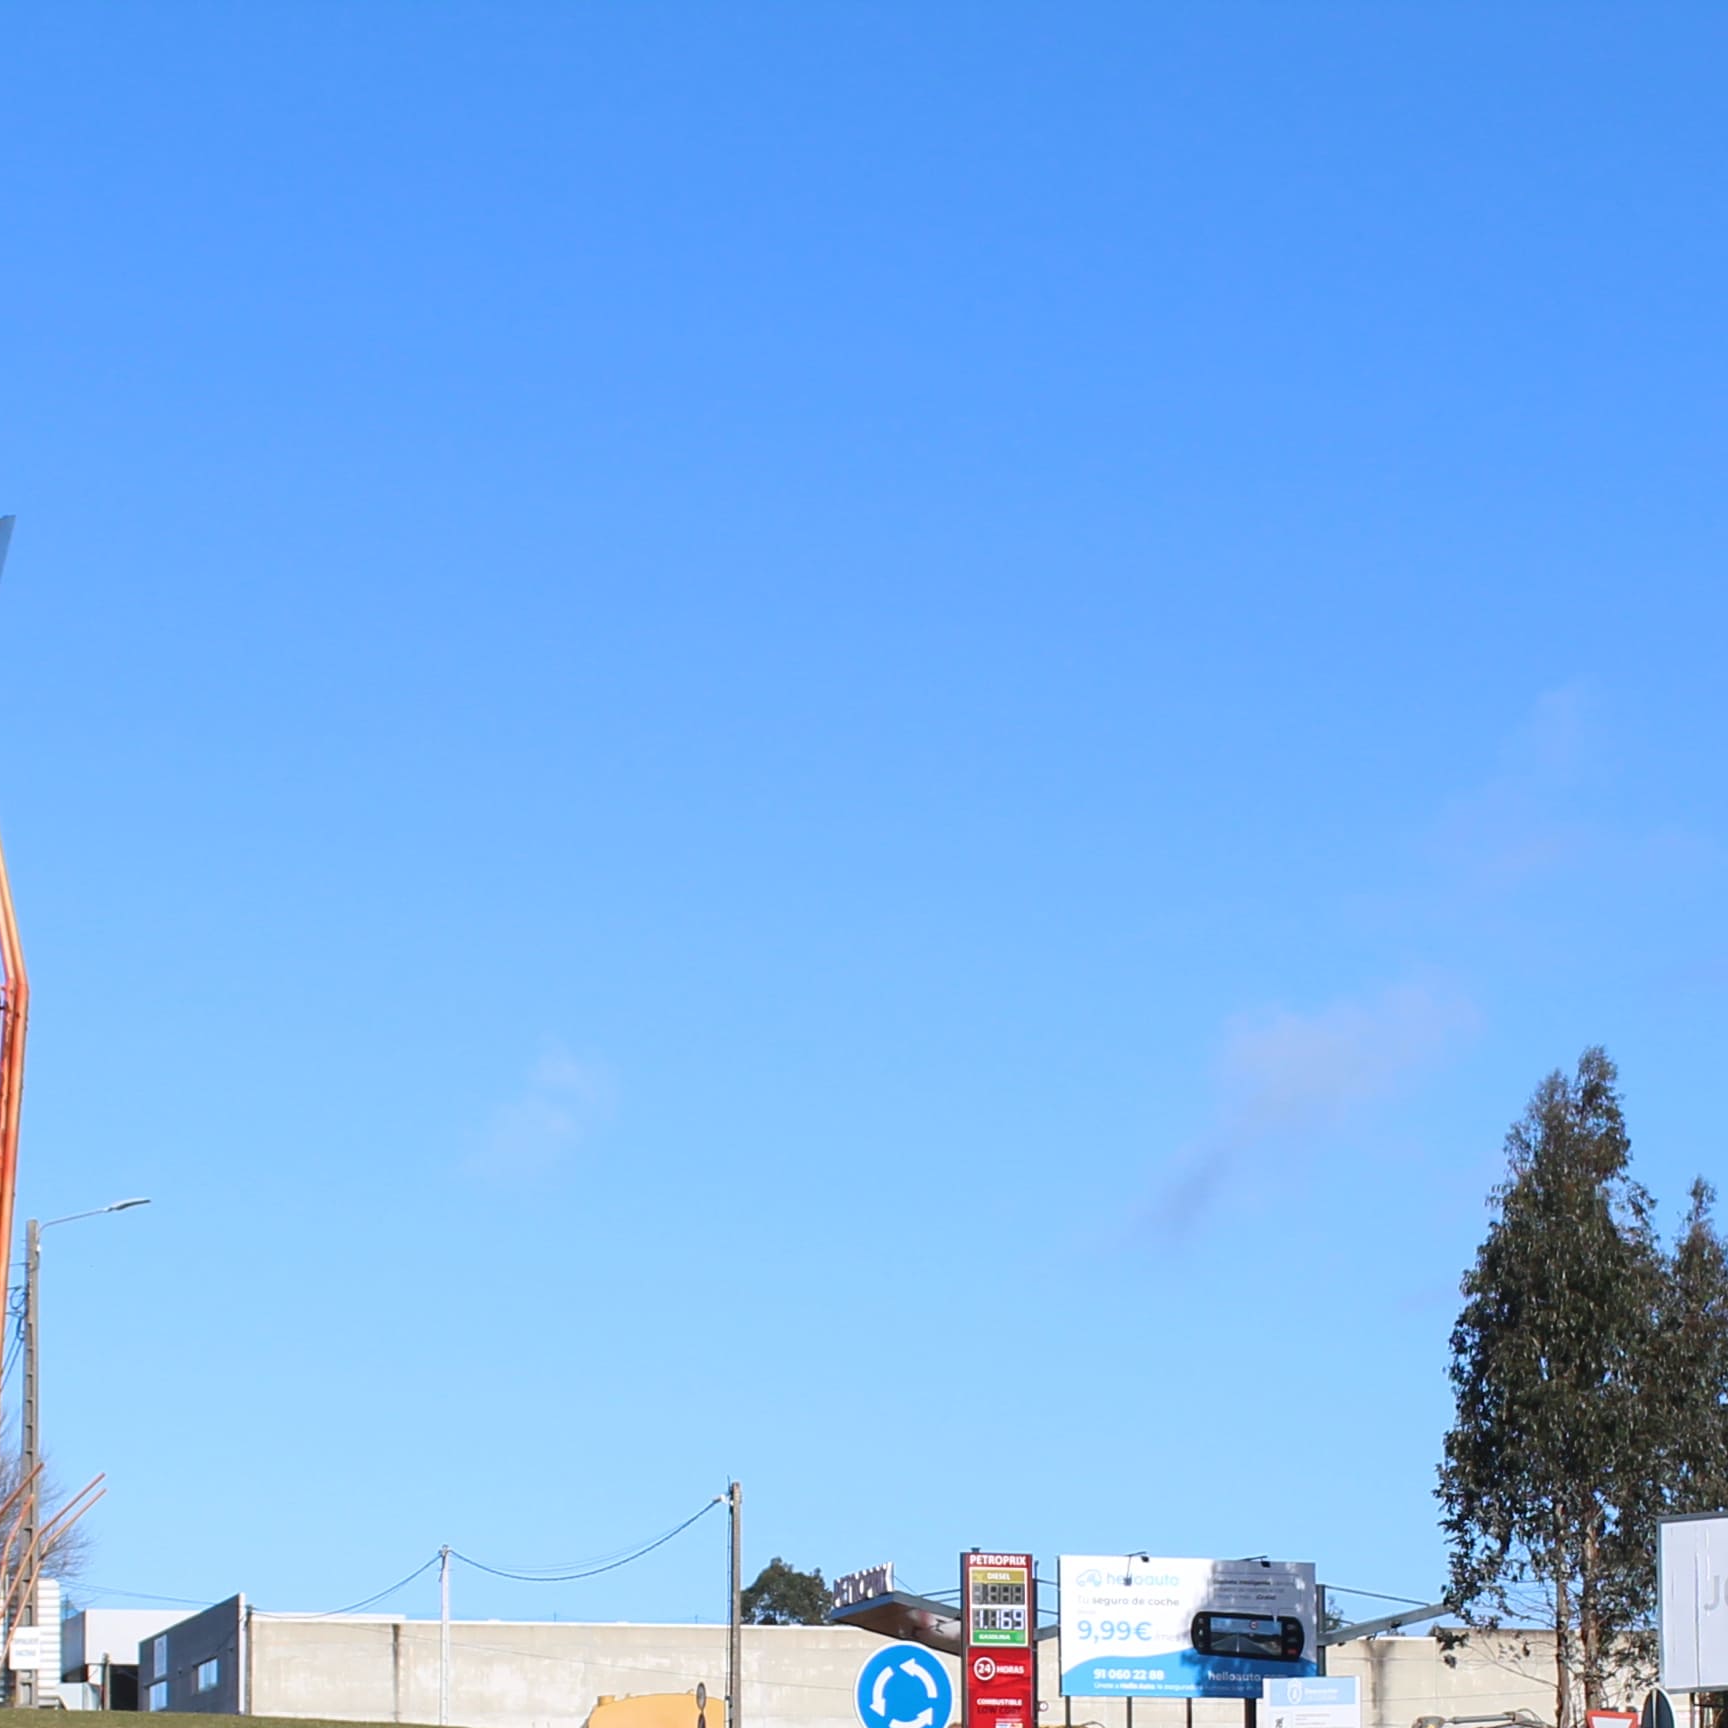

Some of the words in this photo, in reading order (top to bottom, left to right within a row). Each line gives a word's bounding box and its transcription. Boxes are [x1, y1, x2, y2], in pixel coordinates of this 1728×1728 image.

[969, 1554, 1027, 1566] PETROPRIX
[986, 1572, 1011, 1581] DIESEL
[1092, 1597, 1129, 1606] seguro
[1131, 1596, 1145, 1605] de
[1147, 1597, 1180, 1607] coche
[1077, 1619, 1153, 1645] 9,99€
[978, 1662, 991, 1674] 24
[996, 1664, 1025, 1674] HORAS
[1093, 1668, 1107, 1681] 91
[1131, 1669, 1145, 1681] 22
[976, 1697, 1024, 1706] COMBUSTIBLE
[977, 1706, 997, 1714] LOW
[999, 1707, 1021, 1715] COST
